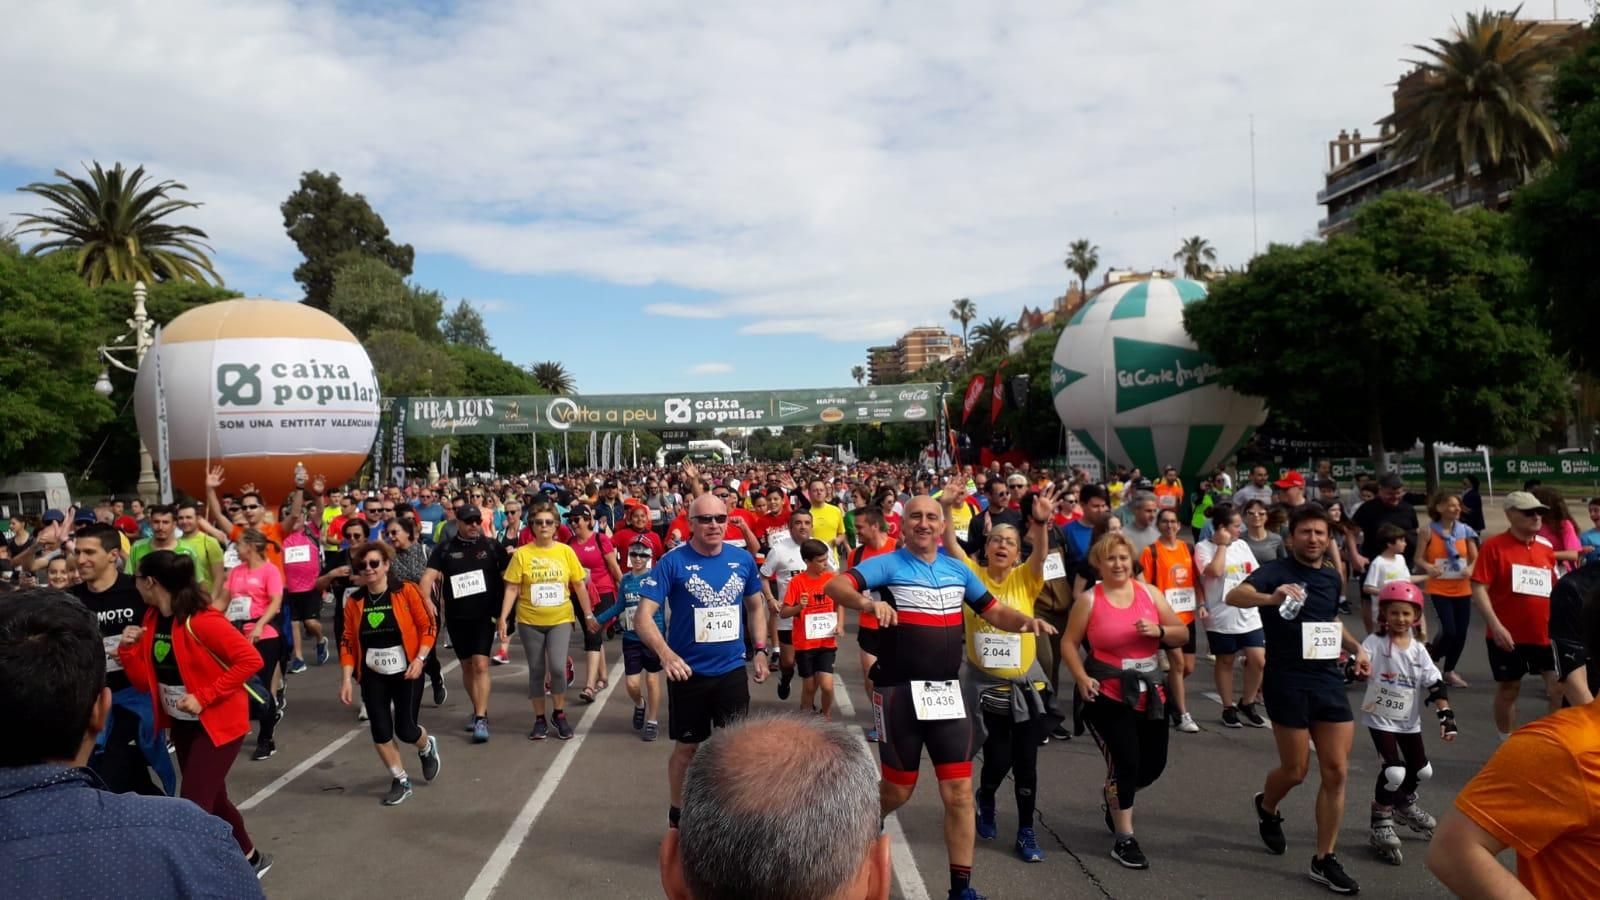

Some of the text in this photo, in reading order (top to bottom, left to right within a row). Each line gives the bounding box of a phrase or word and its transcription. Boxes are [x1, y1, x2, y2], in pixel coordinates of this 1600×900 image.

[271, 359, 350, 379] caixa
[1117, 370, 1134, 388] El
[1135, 367, 1174, 386] Corte
[272, 381, 374, 405] popular
[414, 400, 440, 420] PER
[457, 398, 494, 417] TOTS
[694, 397, 740, 410] caixa
[556, 405, 658, 427] Volta a peu
[695, 408, 765, 422] popular
[219, 419, 245, 430] SOM
[250, 418, 274, 428] UNA
[280, 418, 327, 428] ENTITAT
[705, 619, 733, 630] 4.140
[983, 647, 1011, 657] 2.044
[374, 657, 397, 666] 6.019
[921, 695, 955, 706] 10.436
[1375, 696, 1405, 710] 2.938
